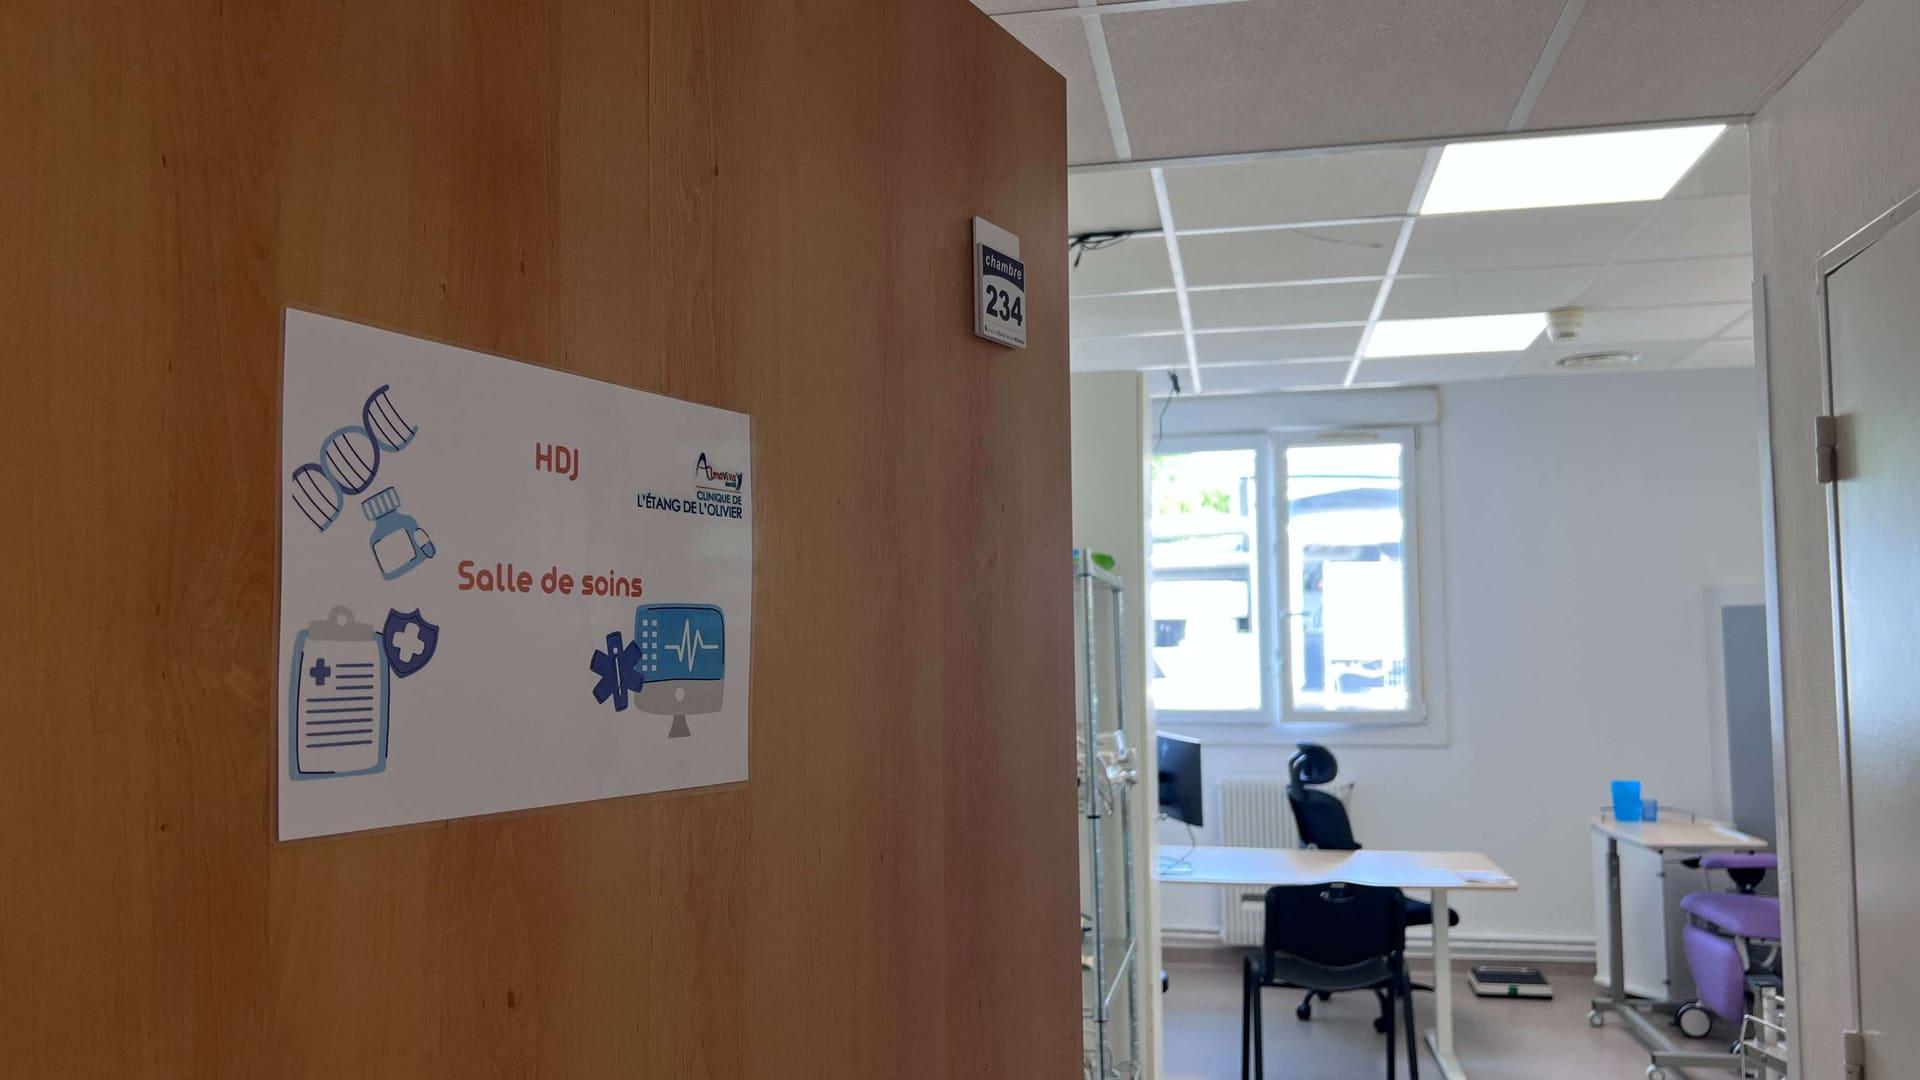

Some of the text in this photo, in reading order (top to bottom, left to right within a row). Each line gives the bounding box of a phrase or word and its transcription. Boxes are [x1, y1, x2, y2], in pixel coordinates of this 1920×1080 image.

[985, 255, 1022, 280] chambre
[986, 284, 1023, 326] 234
[535, 442, 579, 481] HDJ
[637, 492, 742, 519] L'ÉTANG DE L'OLIVIER
[697, 491, 742, 505] CLINIQUE DE
[458, 560, 643, 598] Salle de soins
